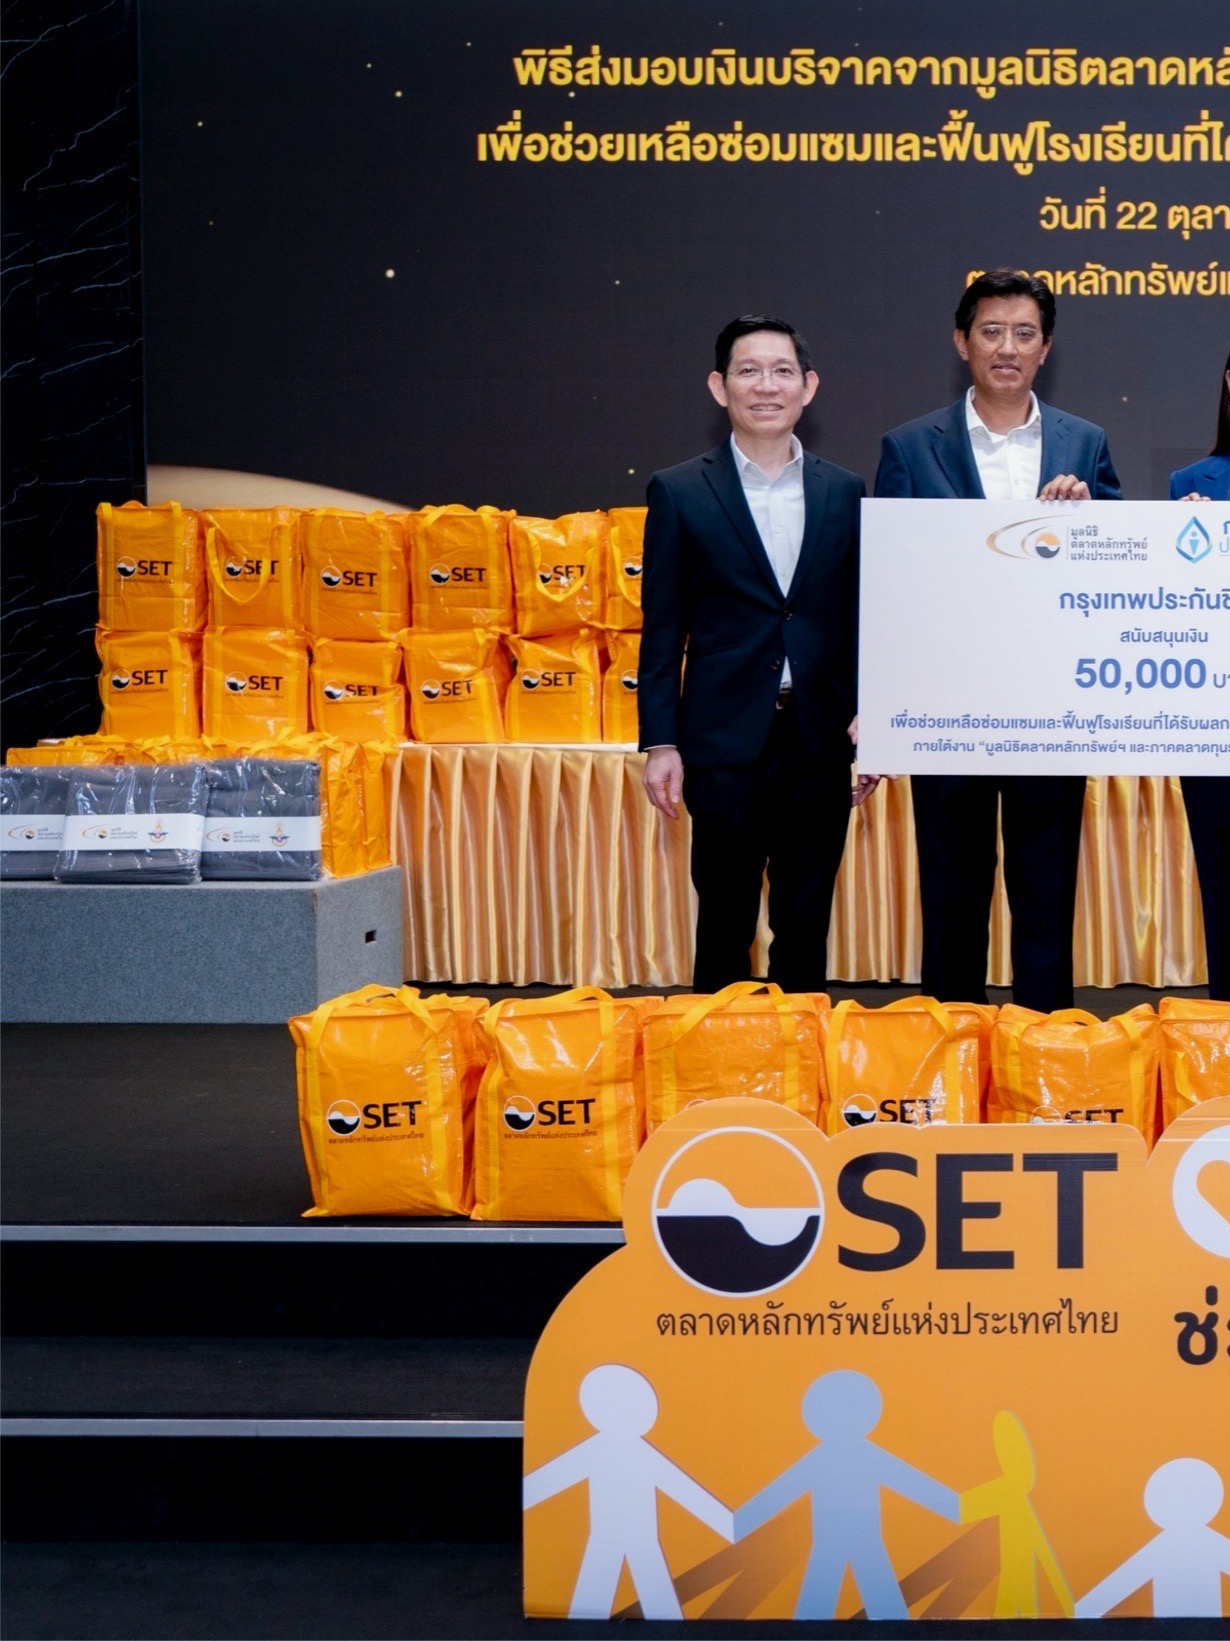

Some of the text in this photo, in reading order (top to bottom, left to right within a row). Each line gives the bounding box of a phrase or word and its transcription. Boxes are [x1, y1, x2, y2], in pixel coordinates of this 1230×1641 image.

[1039, 186, 1106, 231] วันที่
[1115, 200, 1158, 231] 22
[137, 560, 173, 576] SET
[451, 567, 487, 582] SET
[342, 570, 378, 587] SET
[1120, 628, 1209, 648] สนับสนุนเงิน
[131, 669, 168, 685] SET
[248, 675, 283, 691] SET
[541, 671, 576, 687] SET
[1075, 658, 1207, 695] 50,000
[345, 684, 379, 697] SET
[441, 679, 473, 697] SET
[913, 738, 975, 752] ภายใต้งาน
[363, 1100, 422, 1129] SET
[538, 1098, 596, 1126] SET
[837, 1151, 1118, 1273] SET
[656, 1297, 1118, 1336] ตลาดหลักทรัพย์แห่งประเทศไทย
